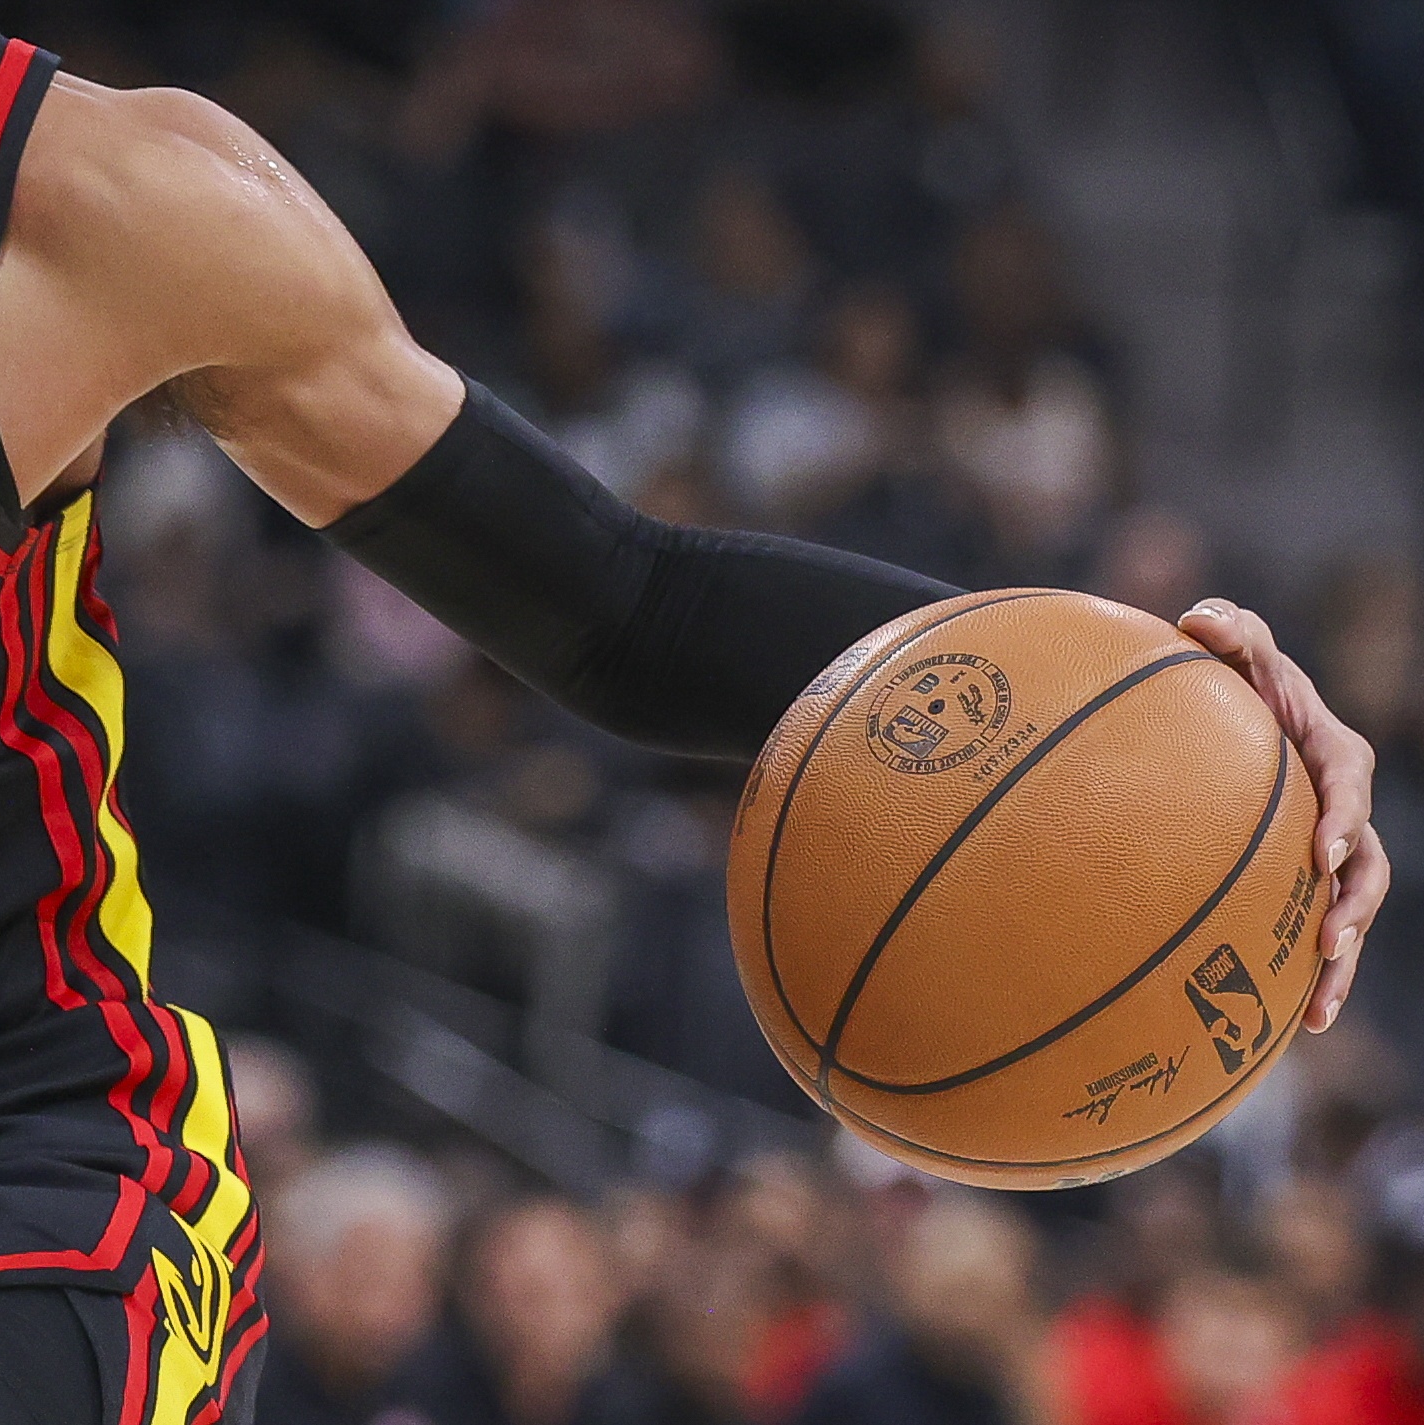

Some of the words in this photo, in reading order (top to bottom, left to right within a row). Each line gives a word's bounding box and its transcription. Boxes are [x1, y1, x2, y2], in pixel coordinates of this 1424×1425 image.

[1284, 913, 1307, 949] GAME
[1267, 948, 1293, 977] BALL
[1085, 1051, 1159, 1097] COMMISSIONER
